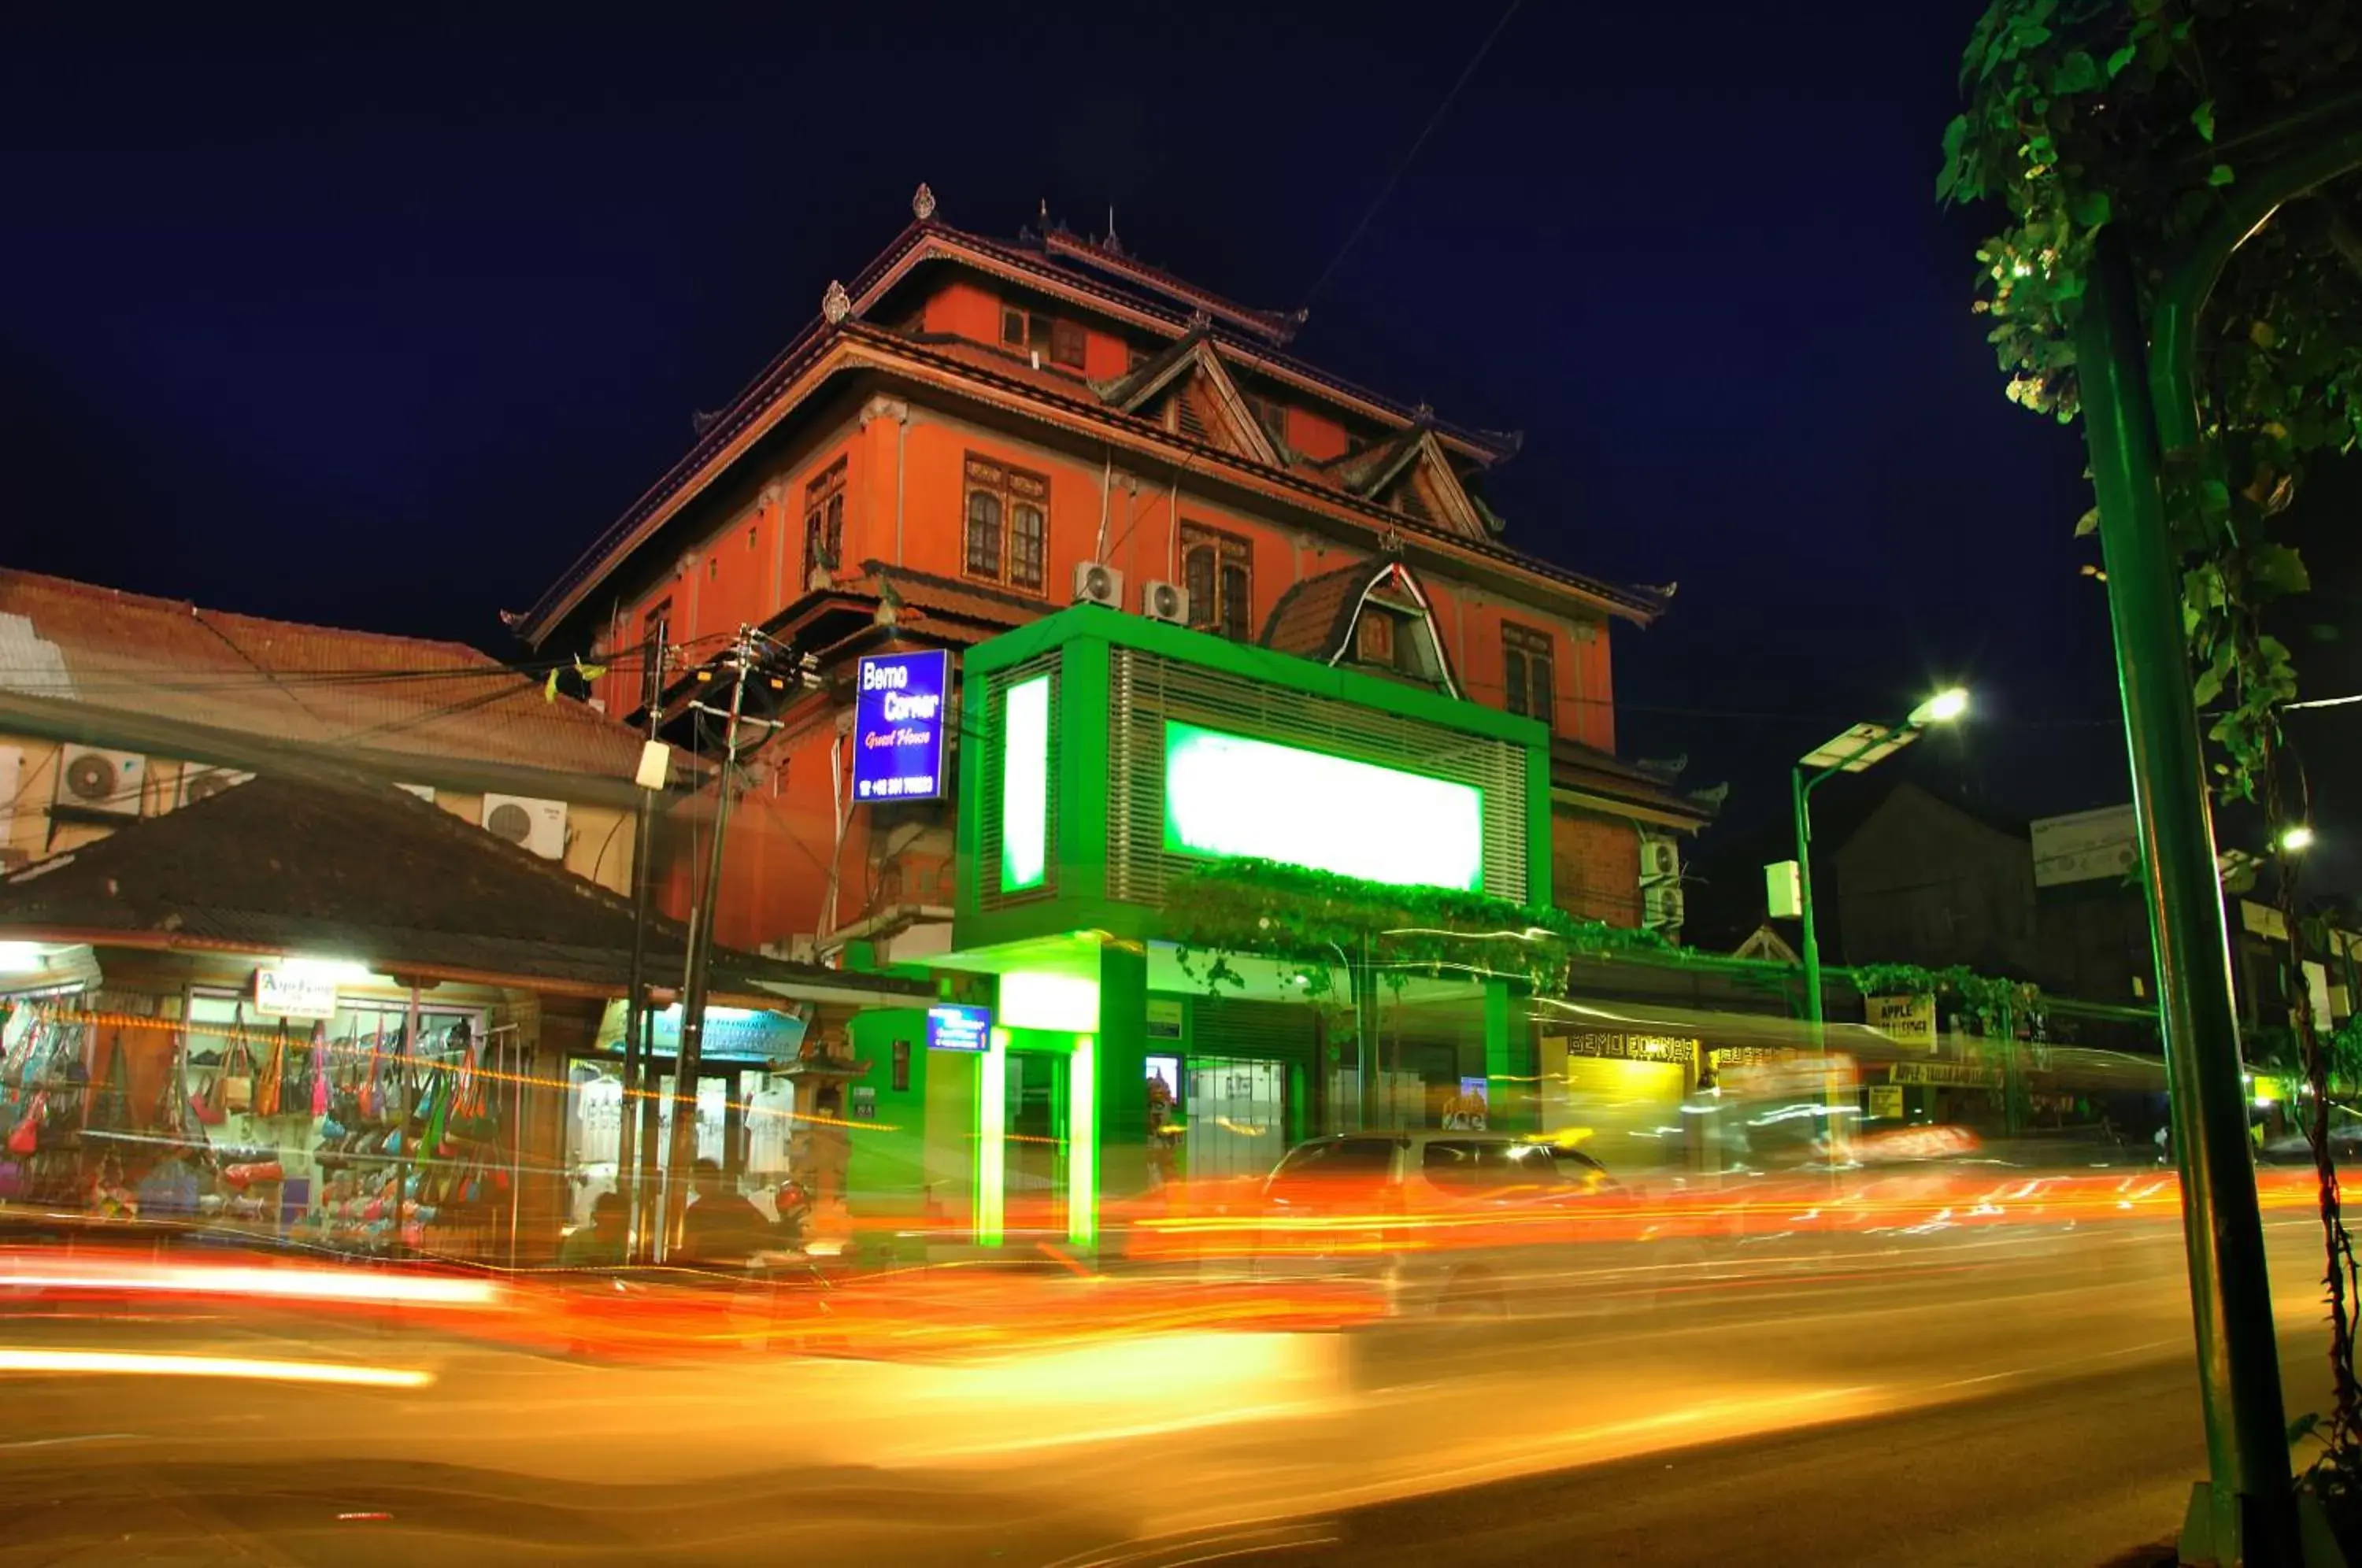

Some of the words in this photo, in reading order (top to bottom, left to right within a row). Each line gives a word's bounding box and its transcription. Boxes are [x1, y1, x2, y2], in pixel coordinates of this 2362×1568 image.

[864, 662, 907, 690] Bemo
[884, 692, 939, 722] Corner
[865, 730, 896, 749] Guest
[897, 728, 930, 746] House
[1881, 1004, 1912, 1019] APPLE
